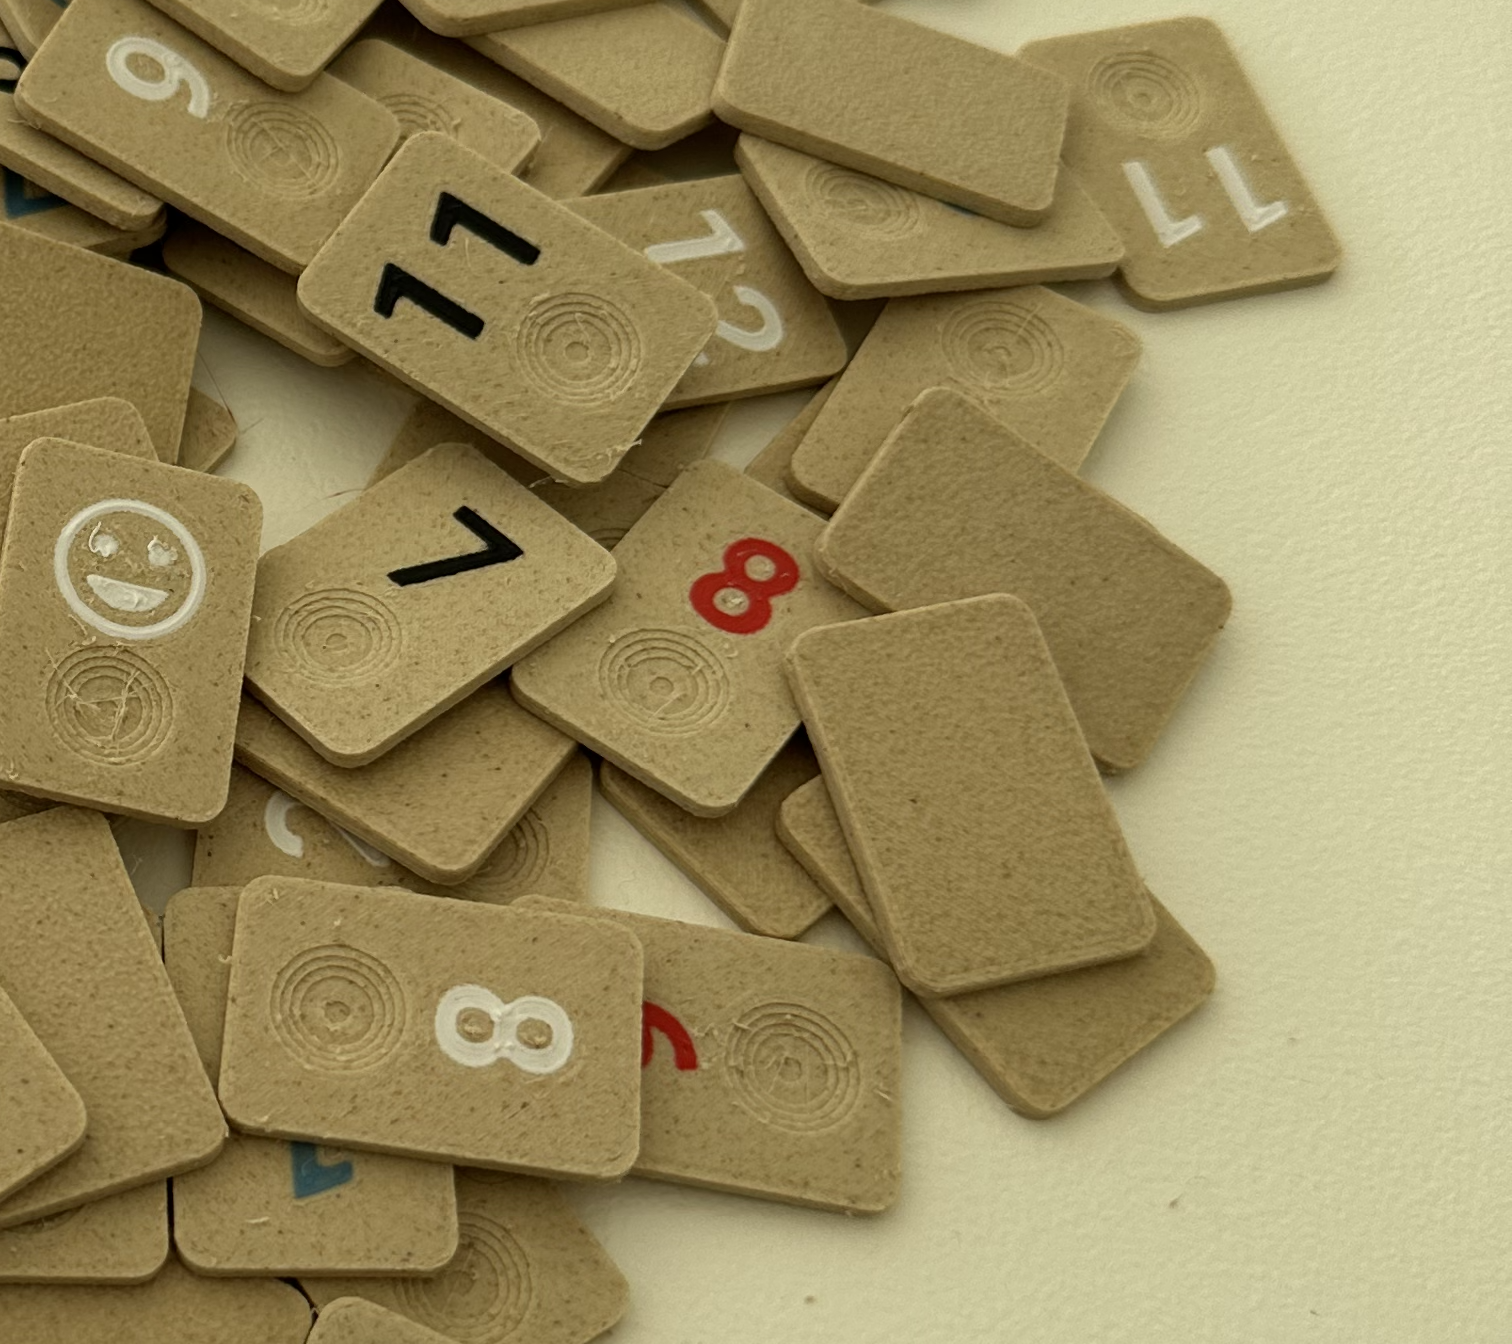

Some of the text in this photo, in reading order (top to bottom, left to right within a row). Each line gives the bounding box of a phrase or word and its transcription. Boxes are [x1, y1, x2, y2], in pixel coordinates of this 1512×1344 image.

[1120, 144, 1288, 250] 11
[373, 190, 542, 341] 11
[386, 504, 525, 587] 7
[689, 536, 802, 635] 8
[434, 982, 575, 1076] 8
